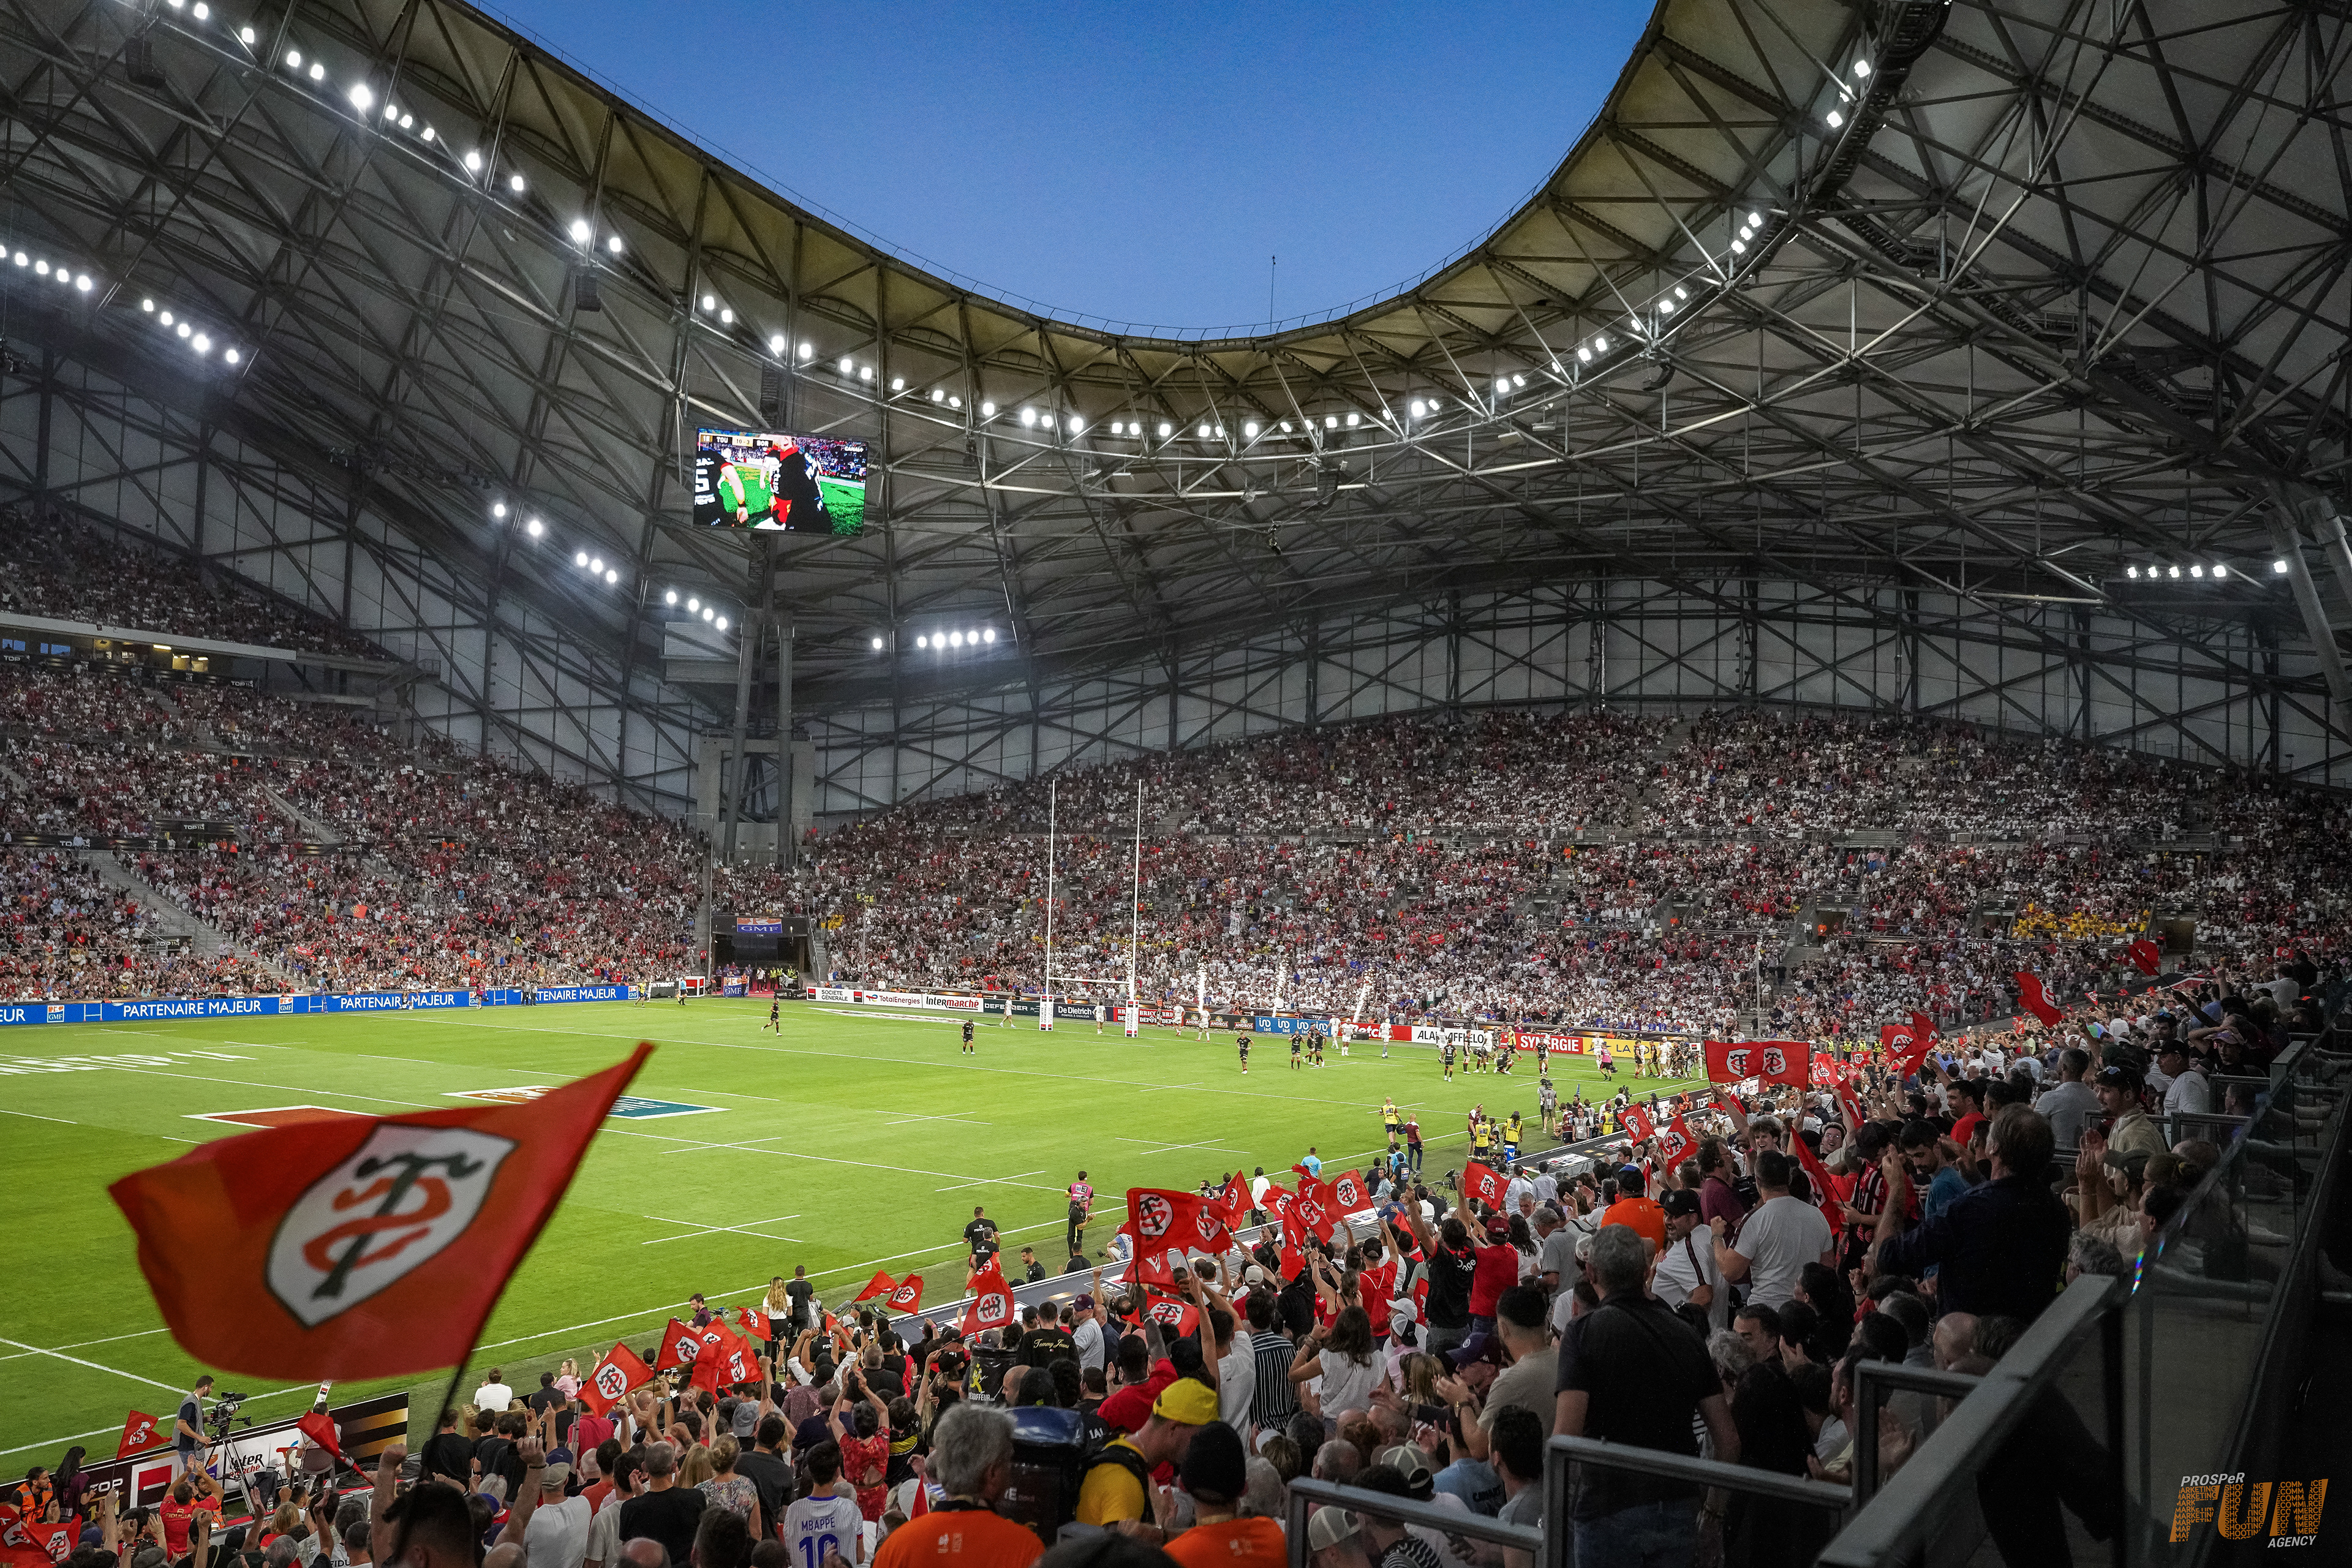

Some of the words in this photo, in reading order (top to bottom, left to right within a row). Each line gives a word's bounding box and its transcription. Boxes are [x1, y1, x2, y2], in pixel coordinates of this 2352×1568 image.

[579, 988, 616, 1000] MAJEUR
[879, 995, 920, 1005] TotalEnergies
[341, 996, 401, 1009] PARTENAIR
[412, 994, 455, 1006] MAJEUR
[124, 1003, 204, 1017] PARTENAIRE
[209, 1000, 262, 1014] MAJEUR
[1067, 1006, 1091, 1015] Dietrich
[1616, 1044, 1630, 1053] LA
[1033, 1338, 1054, 1349] Tommy
[1054, 1339, 1069, 1349] Jeans
[801, 1517, 835, 1531] MBAPPE
[799, 1533, 841, 1568] 10
